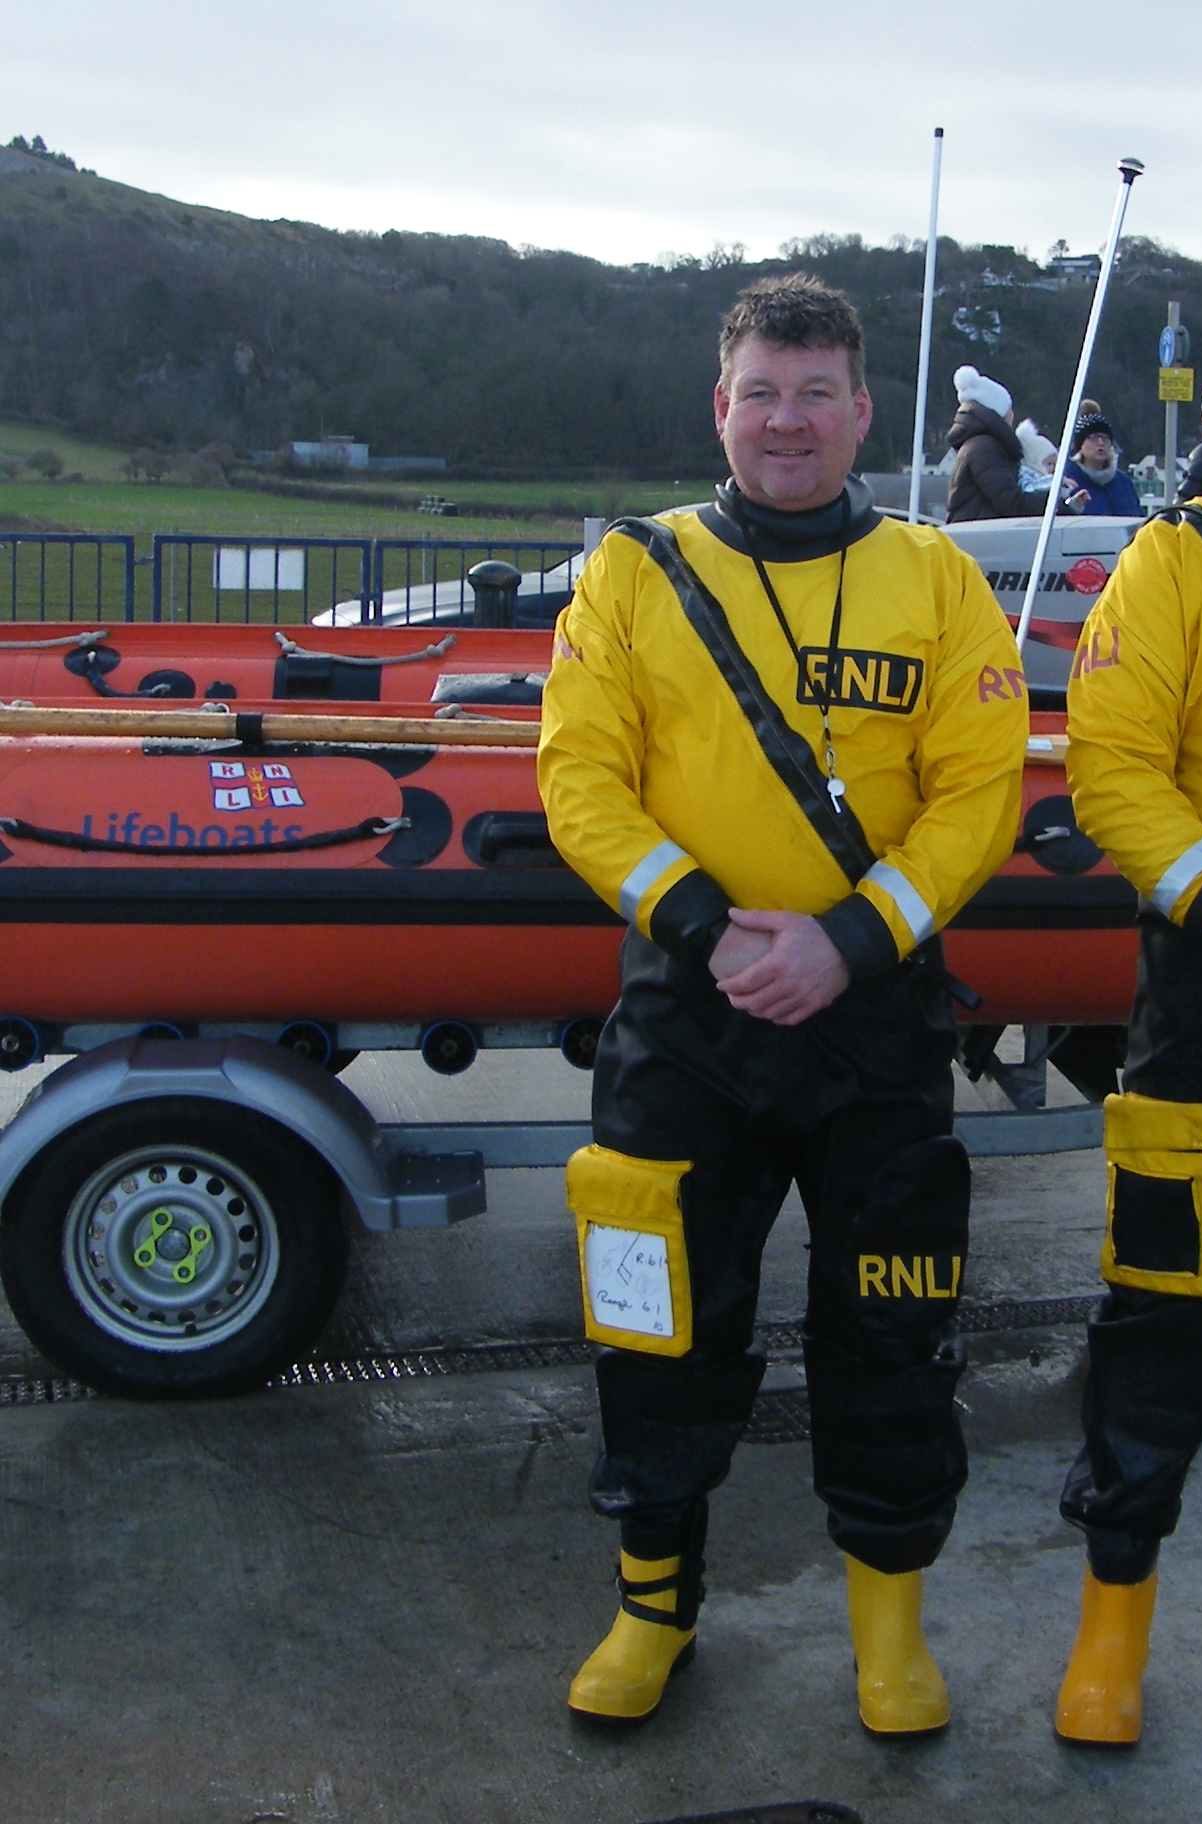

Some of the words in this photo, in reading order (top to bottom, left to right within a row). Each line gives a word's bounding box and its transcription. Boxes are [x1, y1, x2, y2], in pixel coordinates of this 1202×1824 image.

[804, 653, 917, 707] RNLI
[83, 812, 303, 849] Lifeboats
[859, 1254, 961, 1298] RNLI
